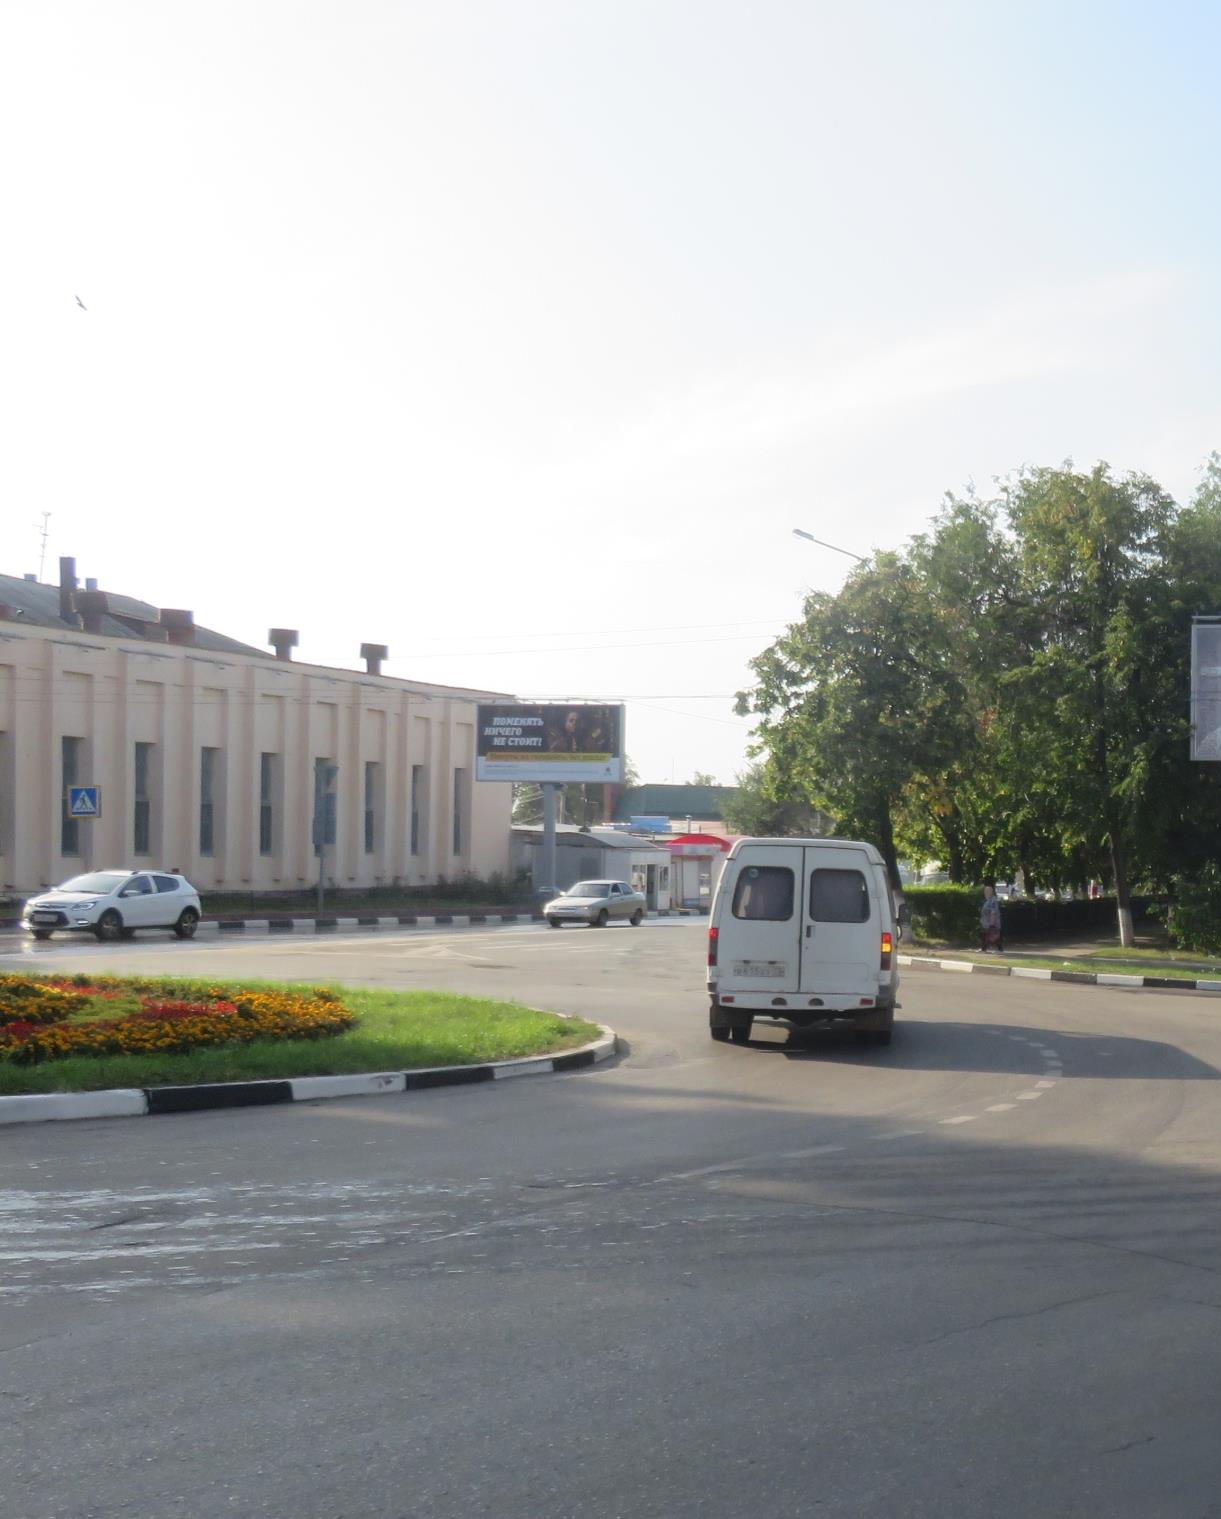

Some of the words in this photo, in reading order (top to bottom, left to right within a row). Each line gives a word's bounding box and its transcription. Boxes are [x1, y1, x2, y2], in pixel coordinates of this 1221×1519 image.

[492, 717, 544, 726] ПОМЕНЯТЬ
[484, 727, 522, 736] НИЧЕГО
[493, 737, 507, 746] НЕ
[508, 737, 542, 746] СТОИТ!
